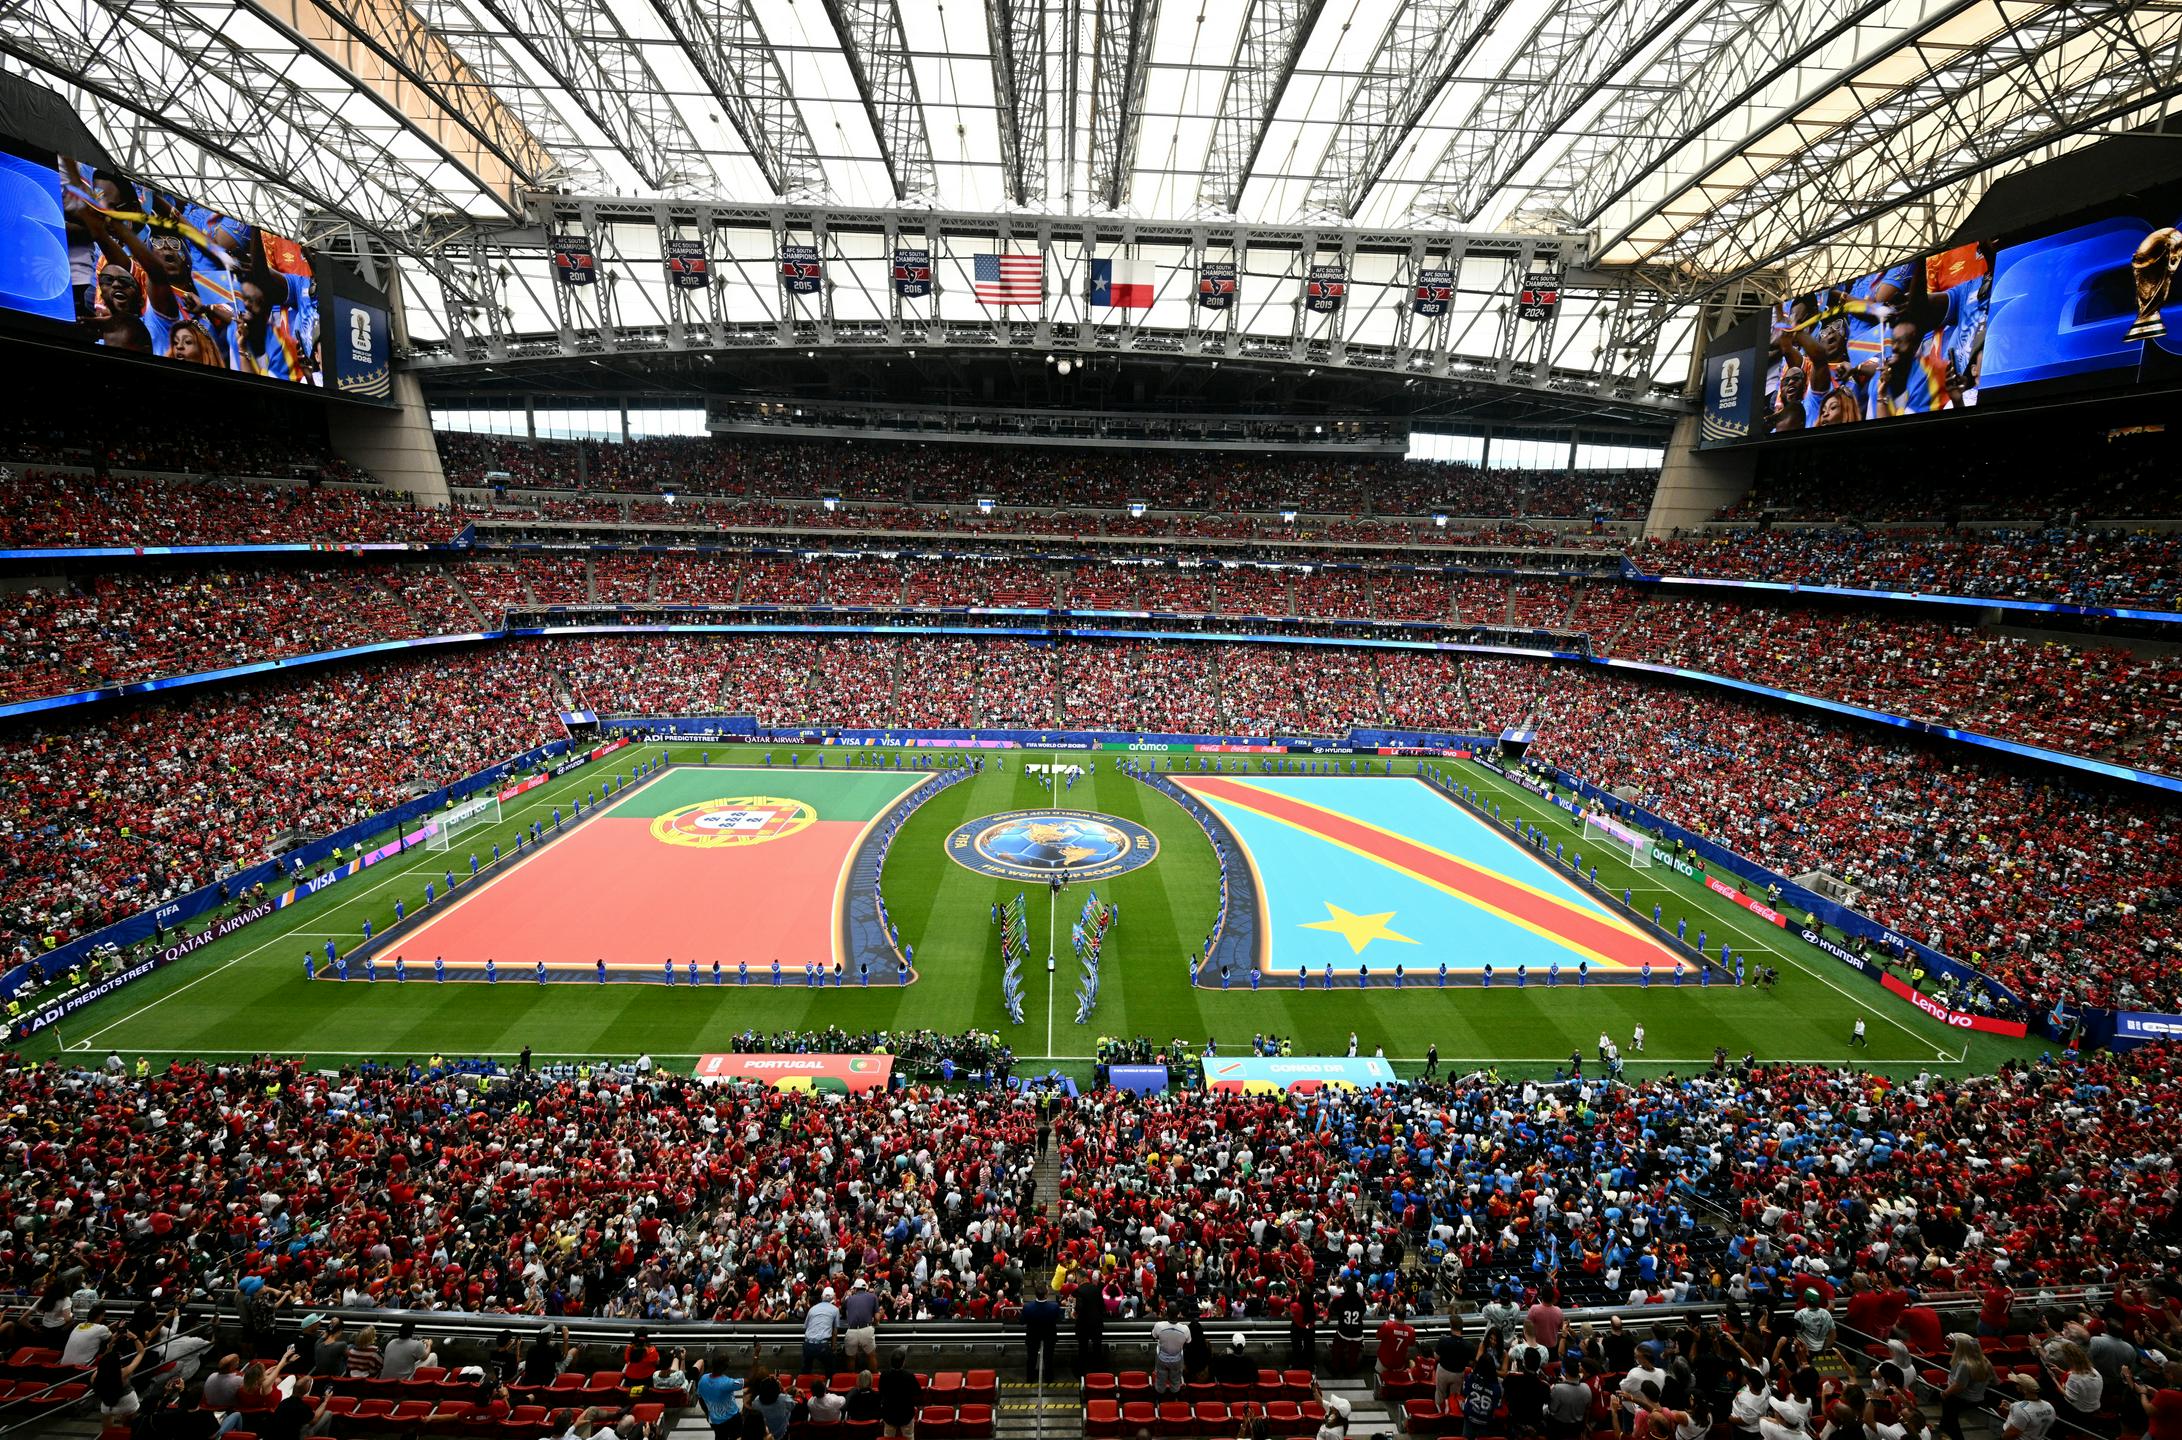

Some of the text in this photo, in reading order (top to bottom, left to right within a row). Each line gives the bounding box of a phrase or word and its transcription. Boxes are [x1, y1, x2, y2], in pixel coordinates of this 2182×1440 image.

[570, 272, 586, 281] 2011
[681, 276, 700, 285] 2012
[794, 282, 812, 290] 2015
[904, 285, 922, 294] 2016
[1206, 298, 1224, 306] 2018
[1315, 300, 1333, 308] 2019
[1422, 304, 1440, 312] 2023
[1525, 308, 1545, 317] 2024
[352, 354, 372, 364] 2026
[1719, 401, 1736, 410] 2026
[602, 743, 619, 755] Lenovo
[565, 758, 585, 771] HYUNDAI
[1026, 764, 1085, 774] FIFA
[1506, 772, 1542, 795] QATAR AIRWAYS
[1558, 795, 1573, 812] VISA
[955, 834, 971, 849] FIFA
[1136, 835, 1150, 849] FIFA
[982, 864, 1006, 873] FIFA
[1007, 870, 1056, 879] WORLD
[1082, 865, 1123, 877] 2026
[306, 871, 336, 893] VISA
[156, 904, 180, 920] FIFA
[165, 902, 272, 961] QATAR AIRWAYS
[1883, 931, 1904, 948] FIFA
[1819, 940, 1863, 970] HYUNDAI
[32, 960, 155, 1032] ADI PREDICTSTREET
[1911, 991, 1973, 1027] Lenovo
[744, 1061, 824, 1069] PORTUGAL
[1270, 1064, 1345, 1073] CONGO DR
[1432, 1248, 1443, 1256] 34
[2003, 1300, 2011, 1314] 7
[1343, 1310, 1360, 1325] 32
[1396, 1337, 1404, 1351] 7
[1469, 1391, 1492, 1410] 26
